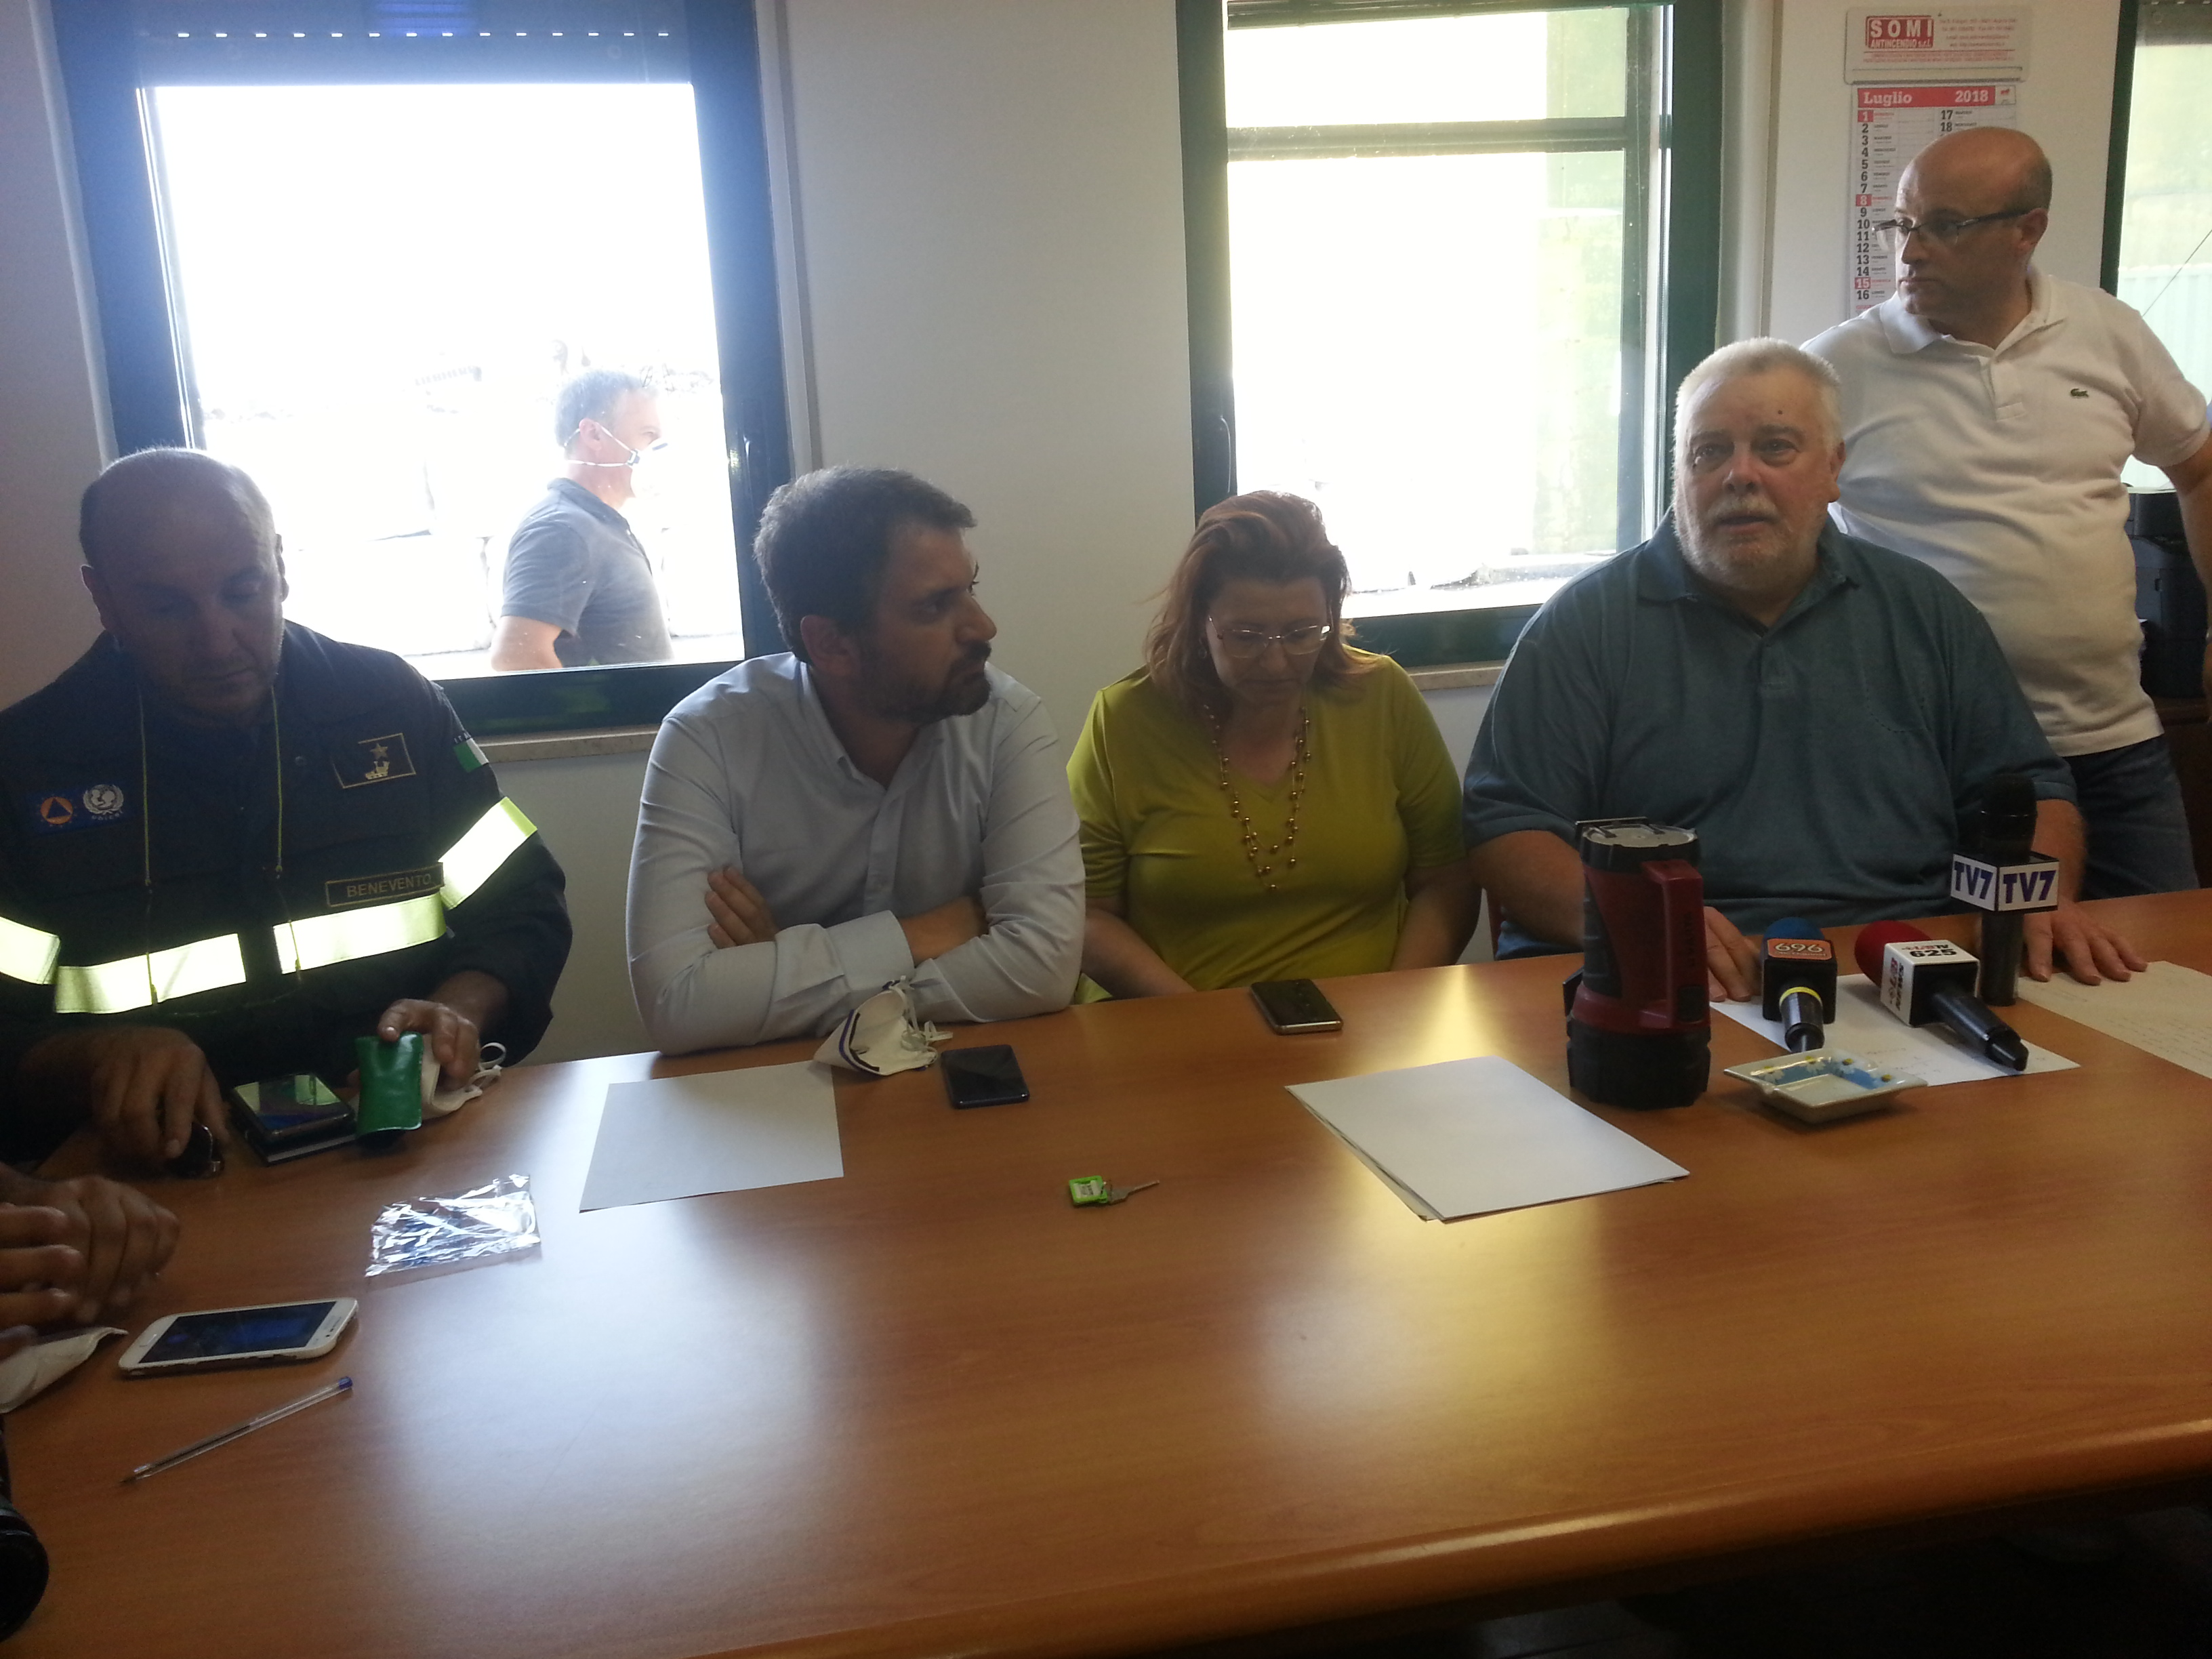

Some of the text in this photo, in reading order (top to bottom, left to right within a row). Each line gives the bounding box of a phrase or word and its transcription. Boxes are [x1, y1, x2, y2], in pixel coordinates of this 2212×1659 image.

[1870, 20, 1932, 38] SOMI
[1870, 39, 1917, 49] ANTINCENDIO
[1864, 89, 1990, 107] Luglio 2018
[1862, 111, 1869, 121] 1
[1941, 110, 1953, 120] 17
[1862, 123, 1868, 134] 2
[1941, 122, 1952, 132] 18
[1862, 136, 1868, 145] 3
[1862, 148, 1868, 157] 4
[1862, 159, 1868, 169] 5
[1861, 171, 1868, 181] 6
[1861, 184, 1867, 194] 7
[1860, 195, 1867, 205] 8
[1860, 207, 1867, 218] 9
[1857, 220, 1870, 230] 10
[1857, 231, 1869, 241] 11
[1857, 243, 1869, 253] 12
[1856, 255, 1869, 265] 13
[1856, 266, 1869, 276] 14
[1856, 278, 1869, 288] 15
[1857, 290, 1869, 300] 16
[346, 873, 432, 898] BENEVENTO
[1954, 861, 1994, 900] TV7
[2003, 870, 2057, 904] TV7
[1774, 943, 1824, 953] 696
[1909, 949, 1957, 958] 625
